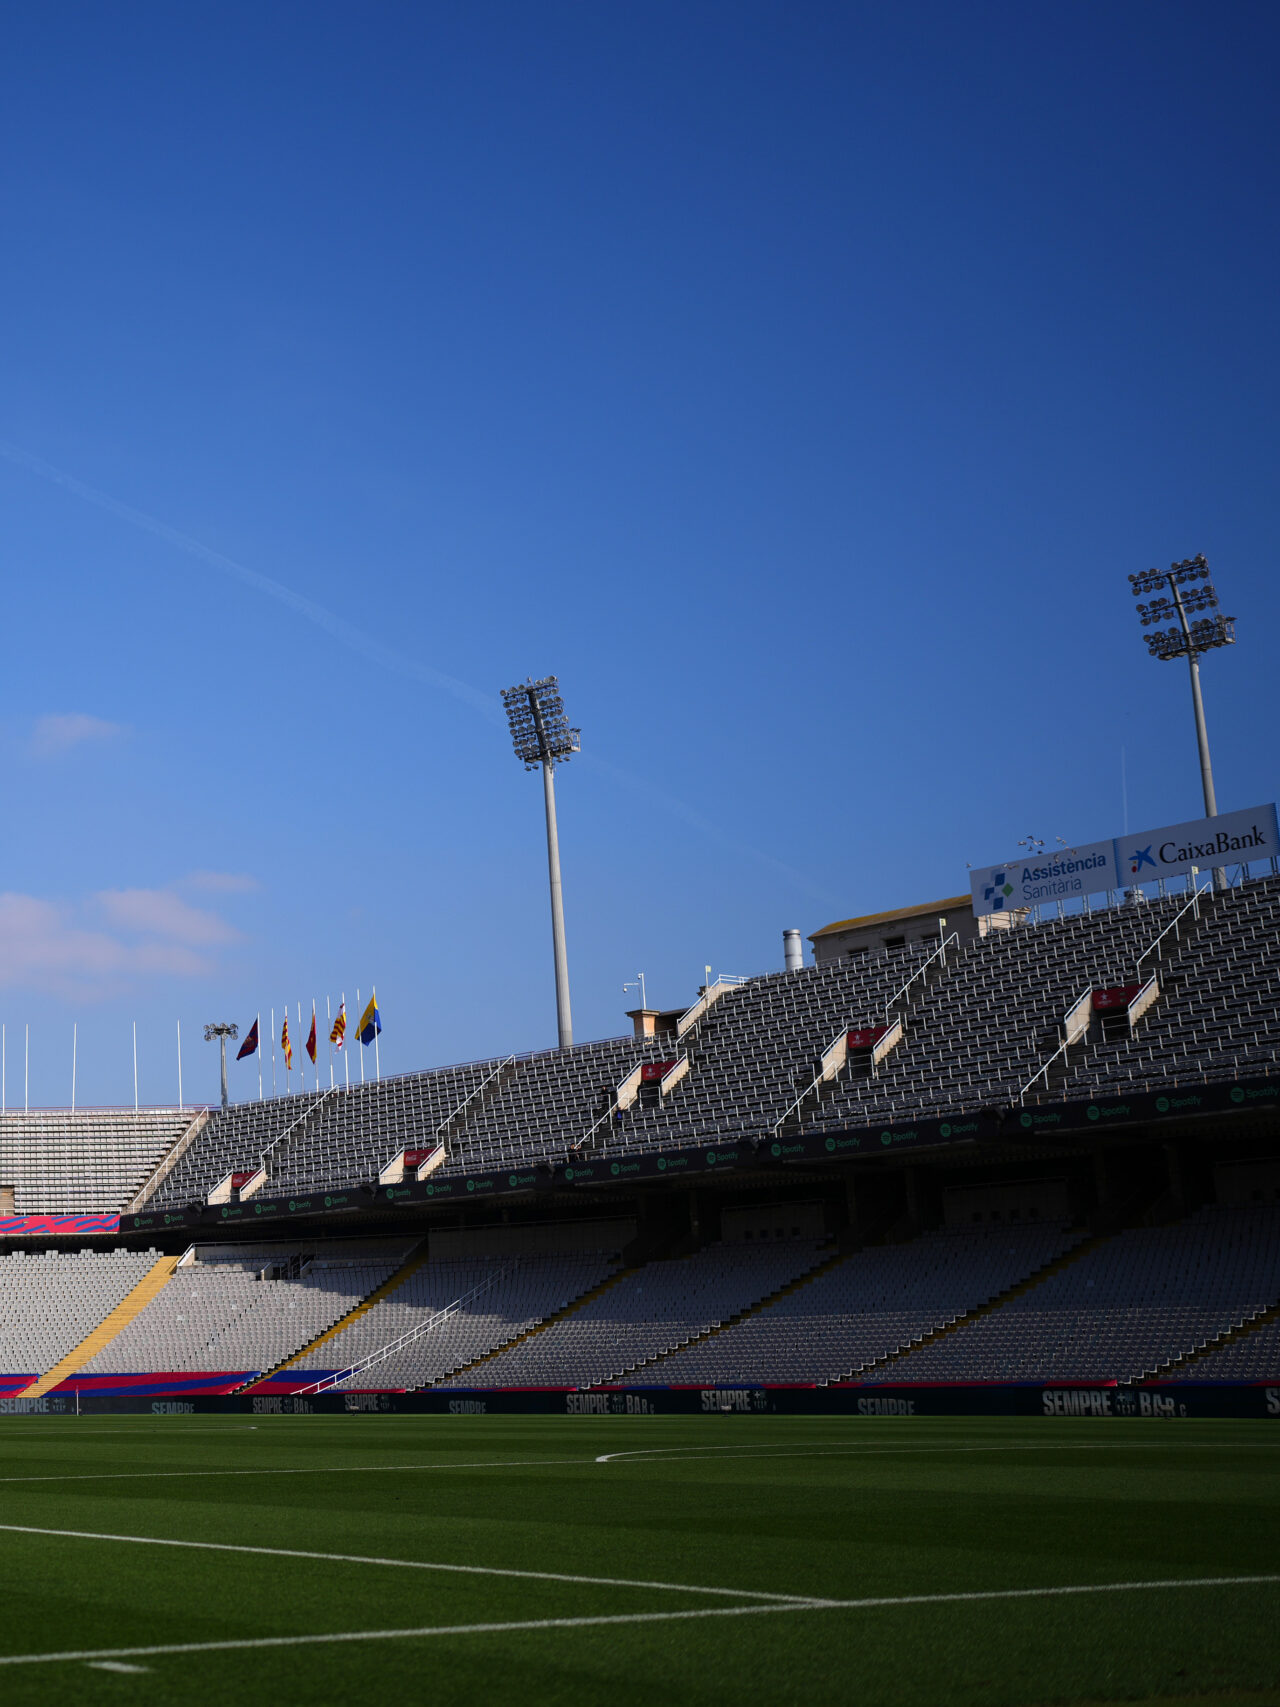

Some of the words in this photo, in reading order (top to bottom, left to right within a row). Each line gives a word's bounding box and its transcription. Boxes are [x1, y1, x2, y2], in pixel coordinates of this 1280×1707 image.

[1159, 825, 1266, 864] CaixaBank
[1021, 852, 1107, 883] Assistència
[1023, 877, 1082, 900] Sanitària
[1170, 1095, 1202, 1108] Spotify
[1100, 1104, 1132, 1117] Spotify
[1033, 1112, 1062, 1124] Spotify
[951, 1123, 979, 1134] Spotify
[893, 1130, 919, 1142] Spotify
[836, 1137, 861, 1148] Spotify
[782, 1144, 805, 1155] Spotify
[667, 1157, 688, 1168] Spotify
[717, 1151, 740, 1162] Spotify
[575, 1167, 594, 1178] Spotify
[620, 1162, 641, 1173] Spotify
[0, 1397, 49, 1414] SEMPRE
[252, 1396, 283, 1414] SEMPRE
[566, 1393, 610, 1414] SEMPRE
[1041, 1389, 1113, 1416] SEMPRE
